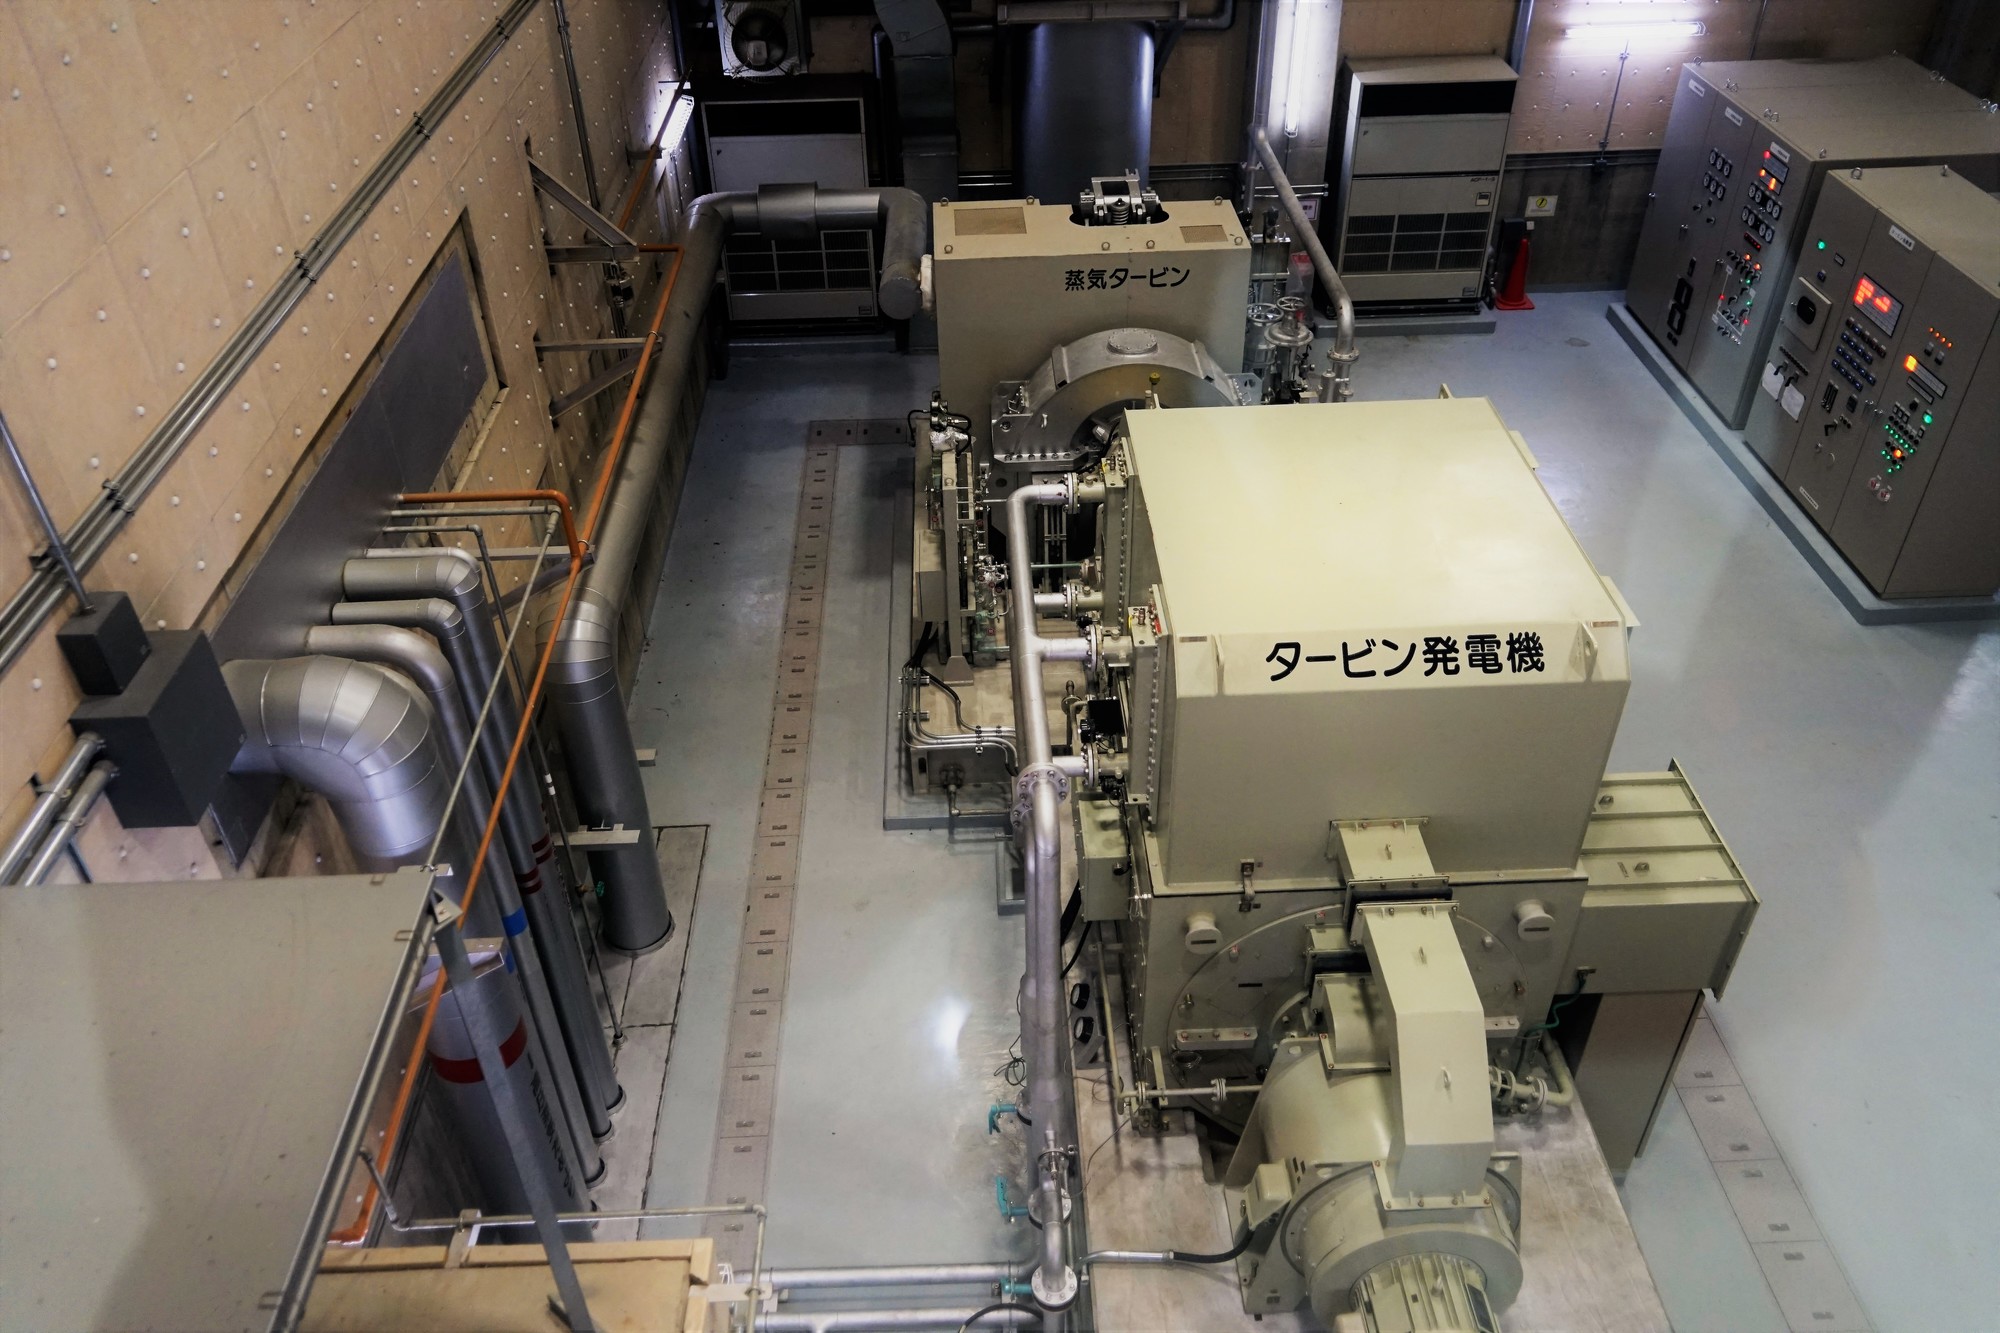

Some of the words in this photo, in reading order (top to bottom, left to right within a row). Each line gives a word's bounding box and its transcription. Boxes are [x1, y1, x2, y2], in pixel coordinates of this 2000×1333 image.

[1065, 266, 1191, 292] 蒸気タービン
[1265, 631, 1545, 682] タービン発電機
